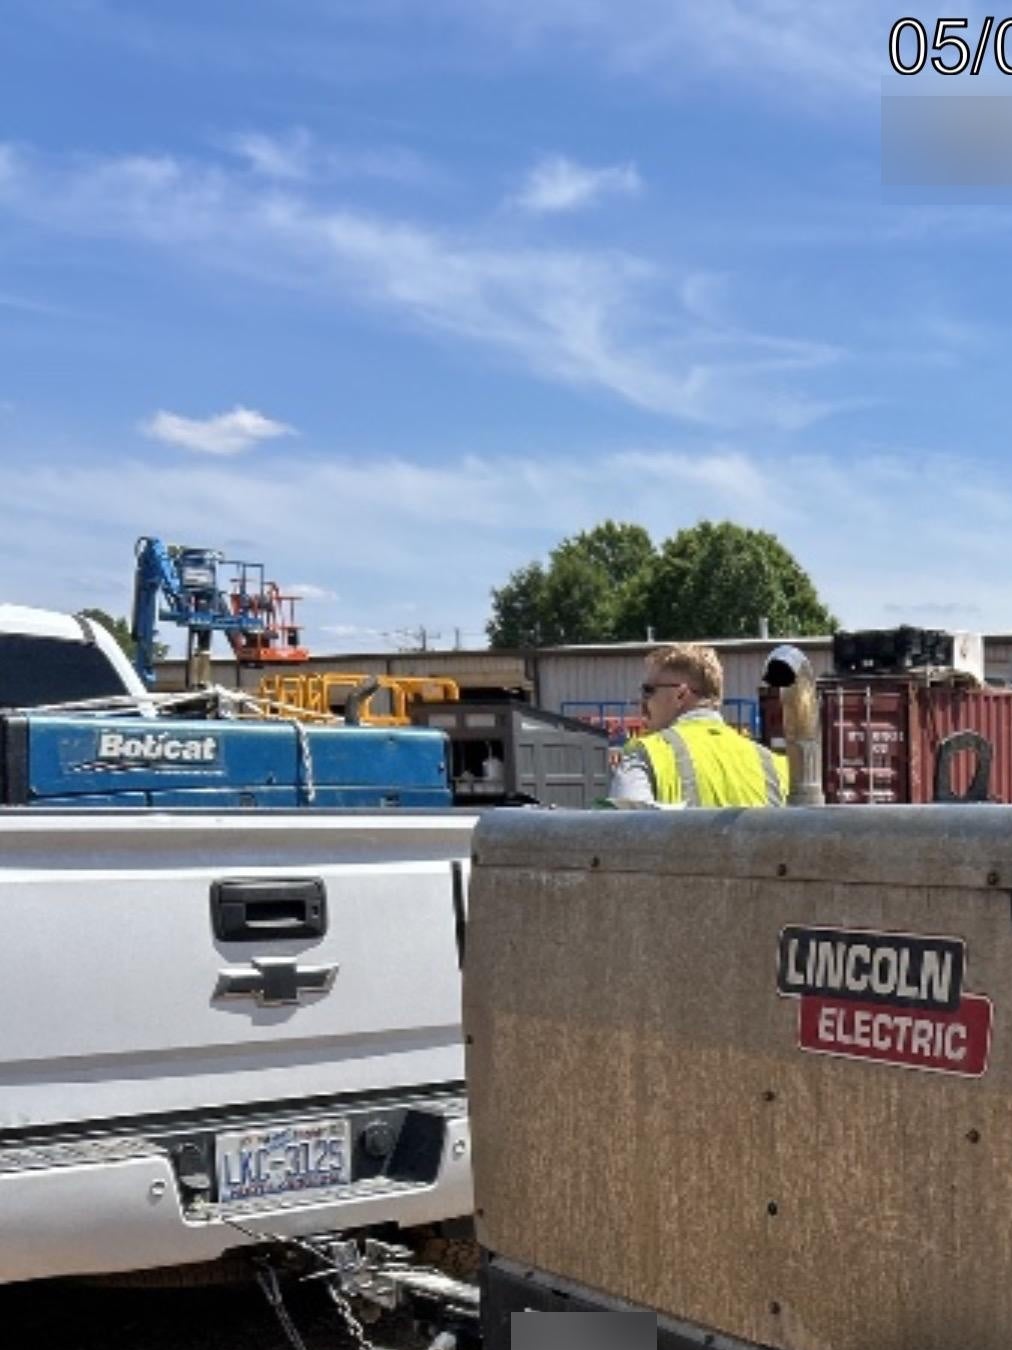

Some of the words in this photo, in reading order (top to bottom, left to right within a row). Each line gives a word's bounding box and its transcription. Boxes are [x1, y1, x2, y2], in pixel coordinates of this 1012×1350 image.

[98, 732, 217, 761] Bobcat
[785, 937, 953, 1004] LINCOLN
[817, 1006, 968, 1061] ELECTRIC
